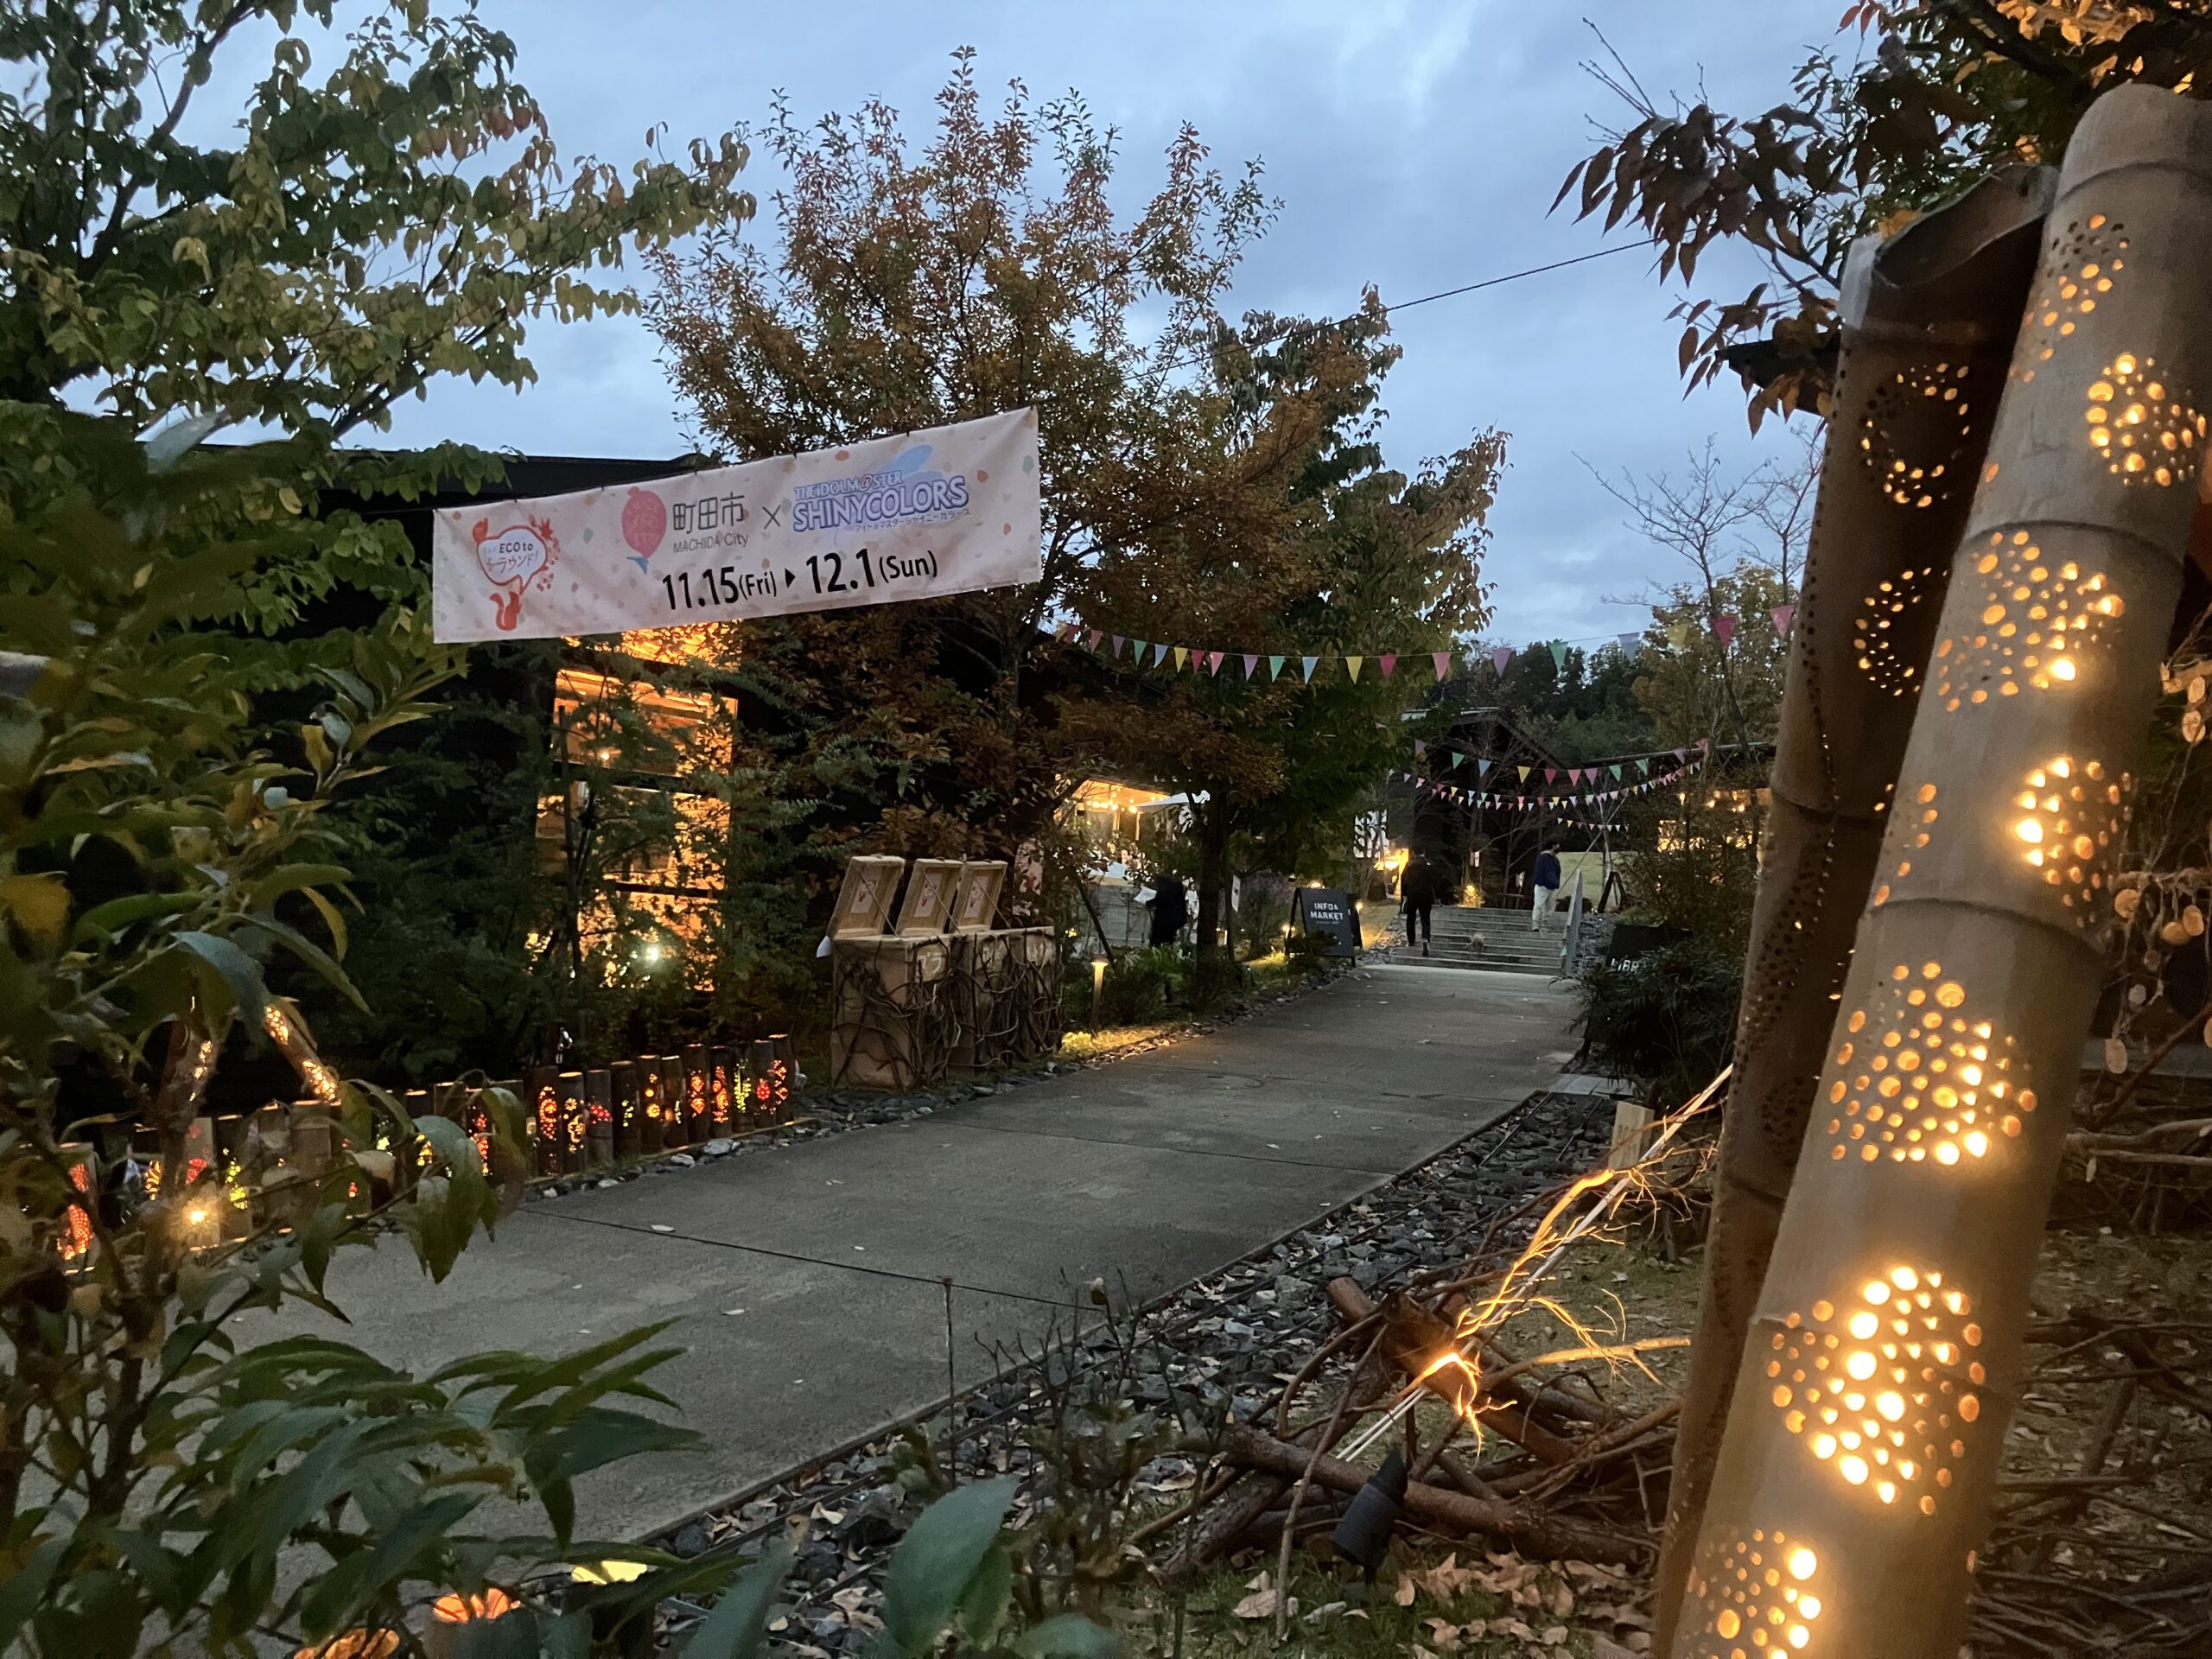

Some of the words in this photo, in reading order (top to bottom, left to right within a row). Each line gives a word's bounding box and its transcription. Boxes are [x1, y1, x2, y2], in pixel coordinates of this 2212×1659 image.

[673, 492, 745, 534] 町田市
[499, 542, 520, 553] ECO
[523, 542, 534, 551] to
[673, 536, 721, 553] MACHIDA
[724, 532, 749, 548] City
[1310, 912, 1344, 920] MARKET
